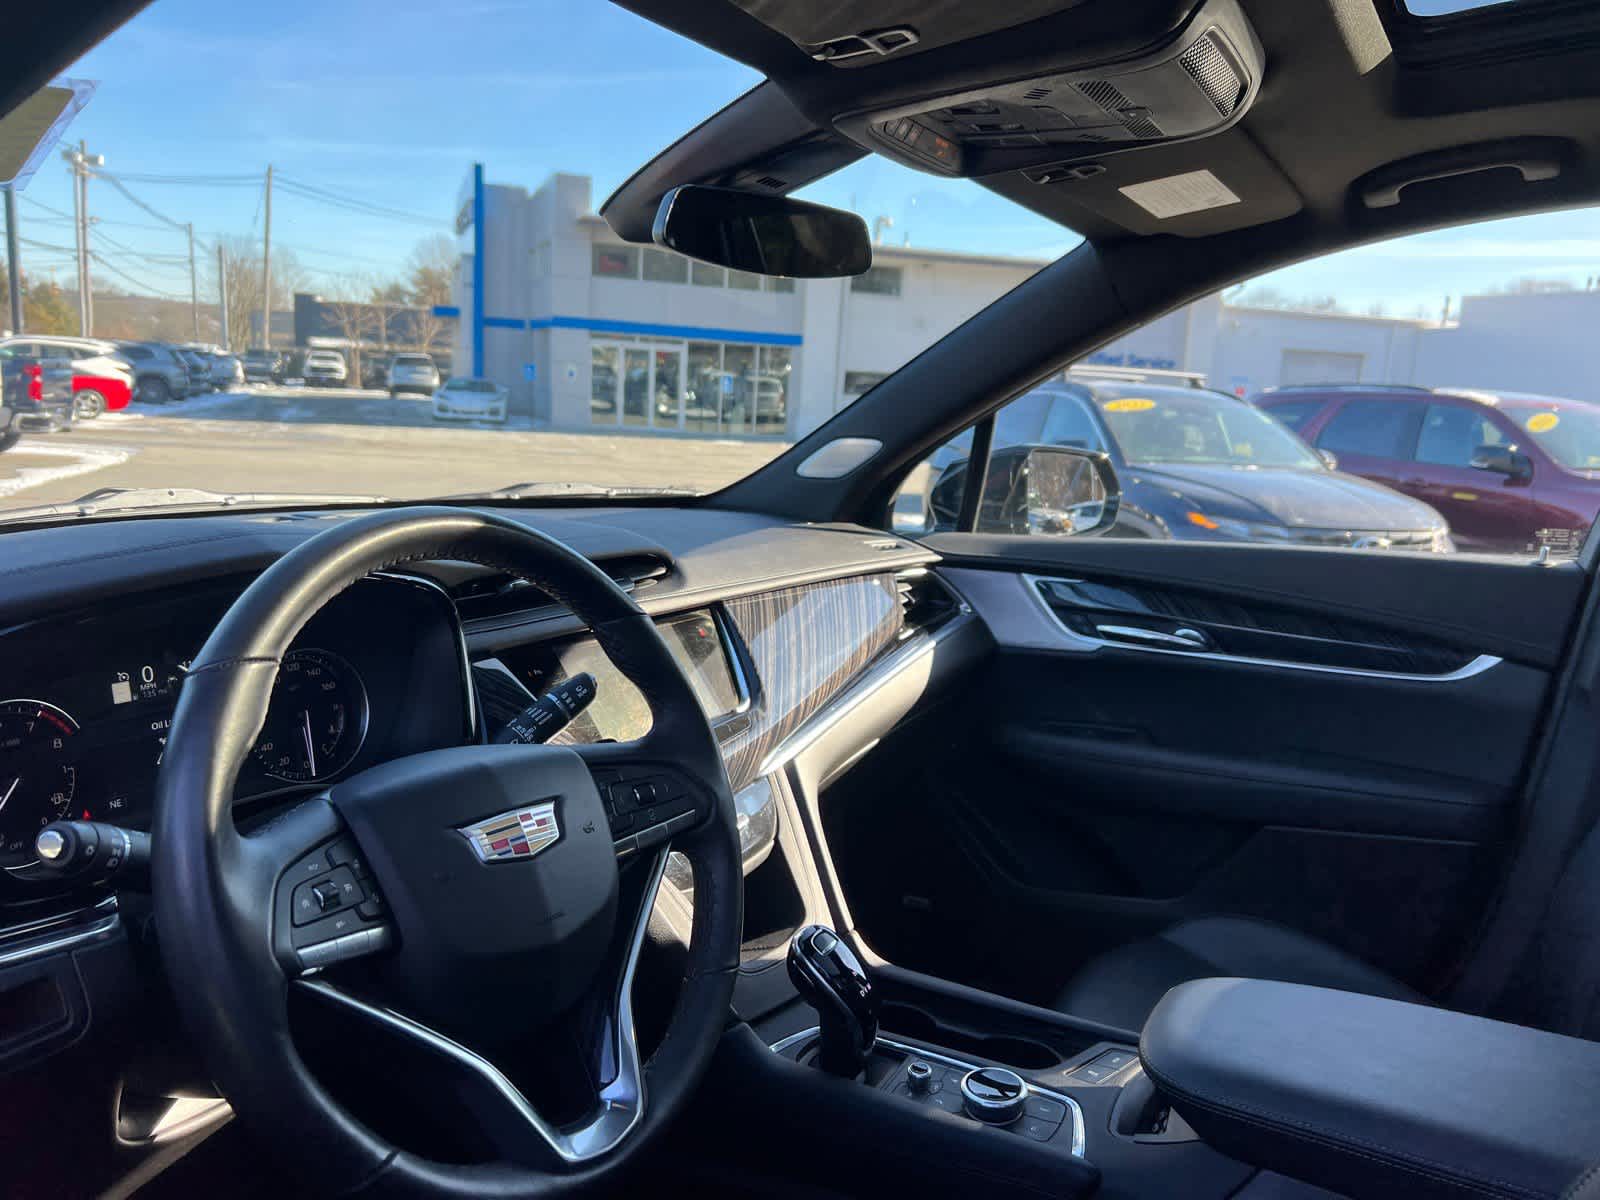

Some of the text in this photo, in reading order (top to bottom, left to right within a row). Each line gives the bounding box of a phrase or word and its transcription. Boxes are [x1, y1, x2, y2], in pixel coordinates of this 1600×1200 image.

[141, 665, 154, 683] 0
[140, 682, 157, 691] MPH
[151, 720, 163, 730] Oil
[109, 799, 122, 808] NE
